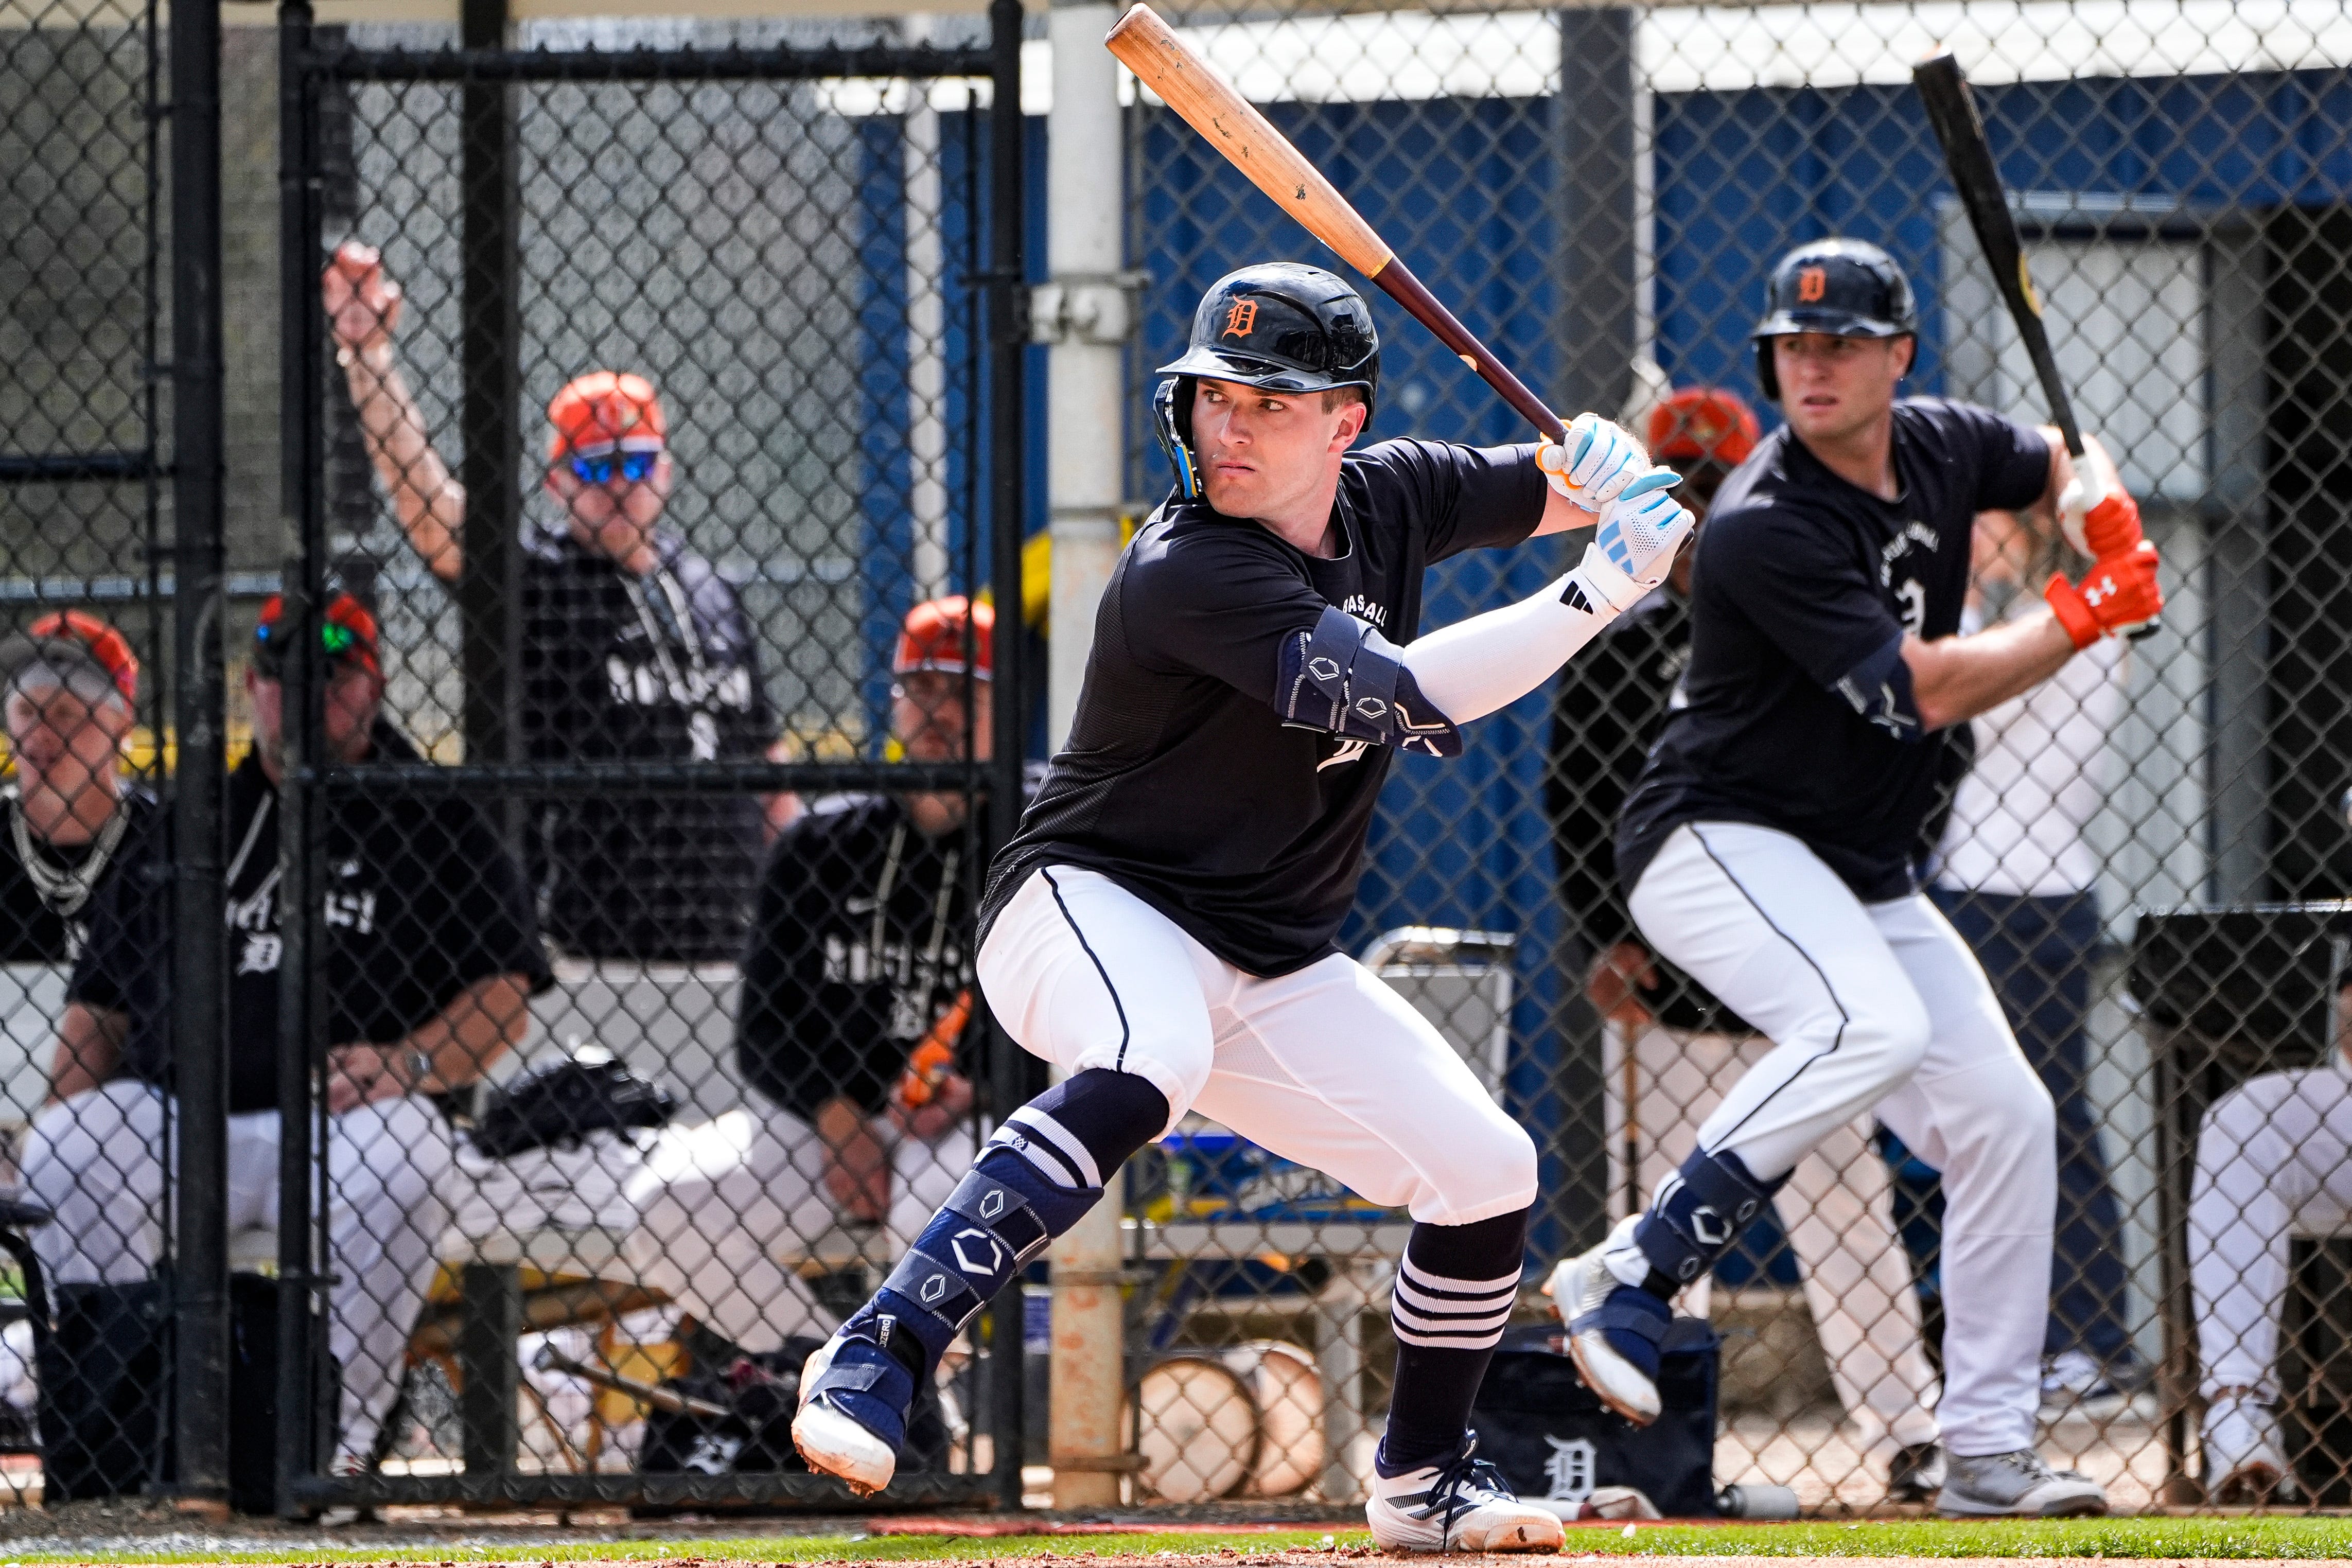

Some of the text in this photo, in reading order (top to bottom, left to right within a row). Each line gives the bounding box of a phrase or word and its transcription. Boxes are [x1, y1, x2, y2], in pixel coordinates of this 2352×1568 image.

[1798, 266, 1827, 303] D
[1222, 294, 1259, 340] D
[1342, 594, 1387, 627] BASALL
[879, 1319, 891, 1348] DIZERO
[1544, 1432, 1598, 1502] D
